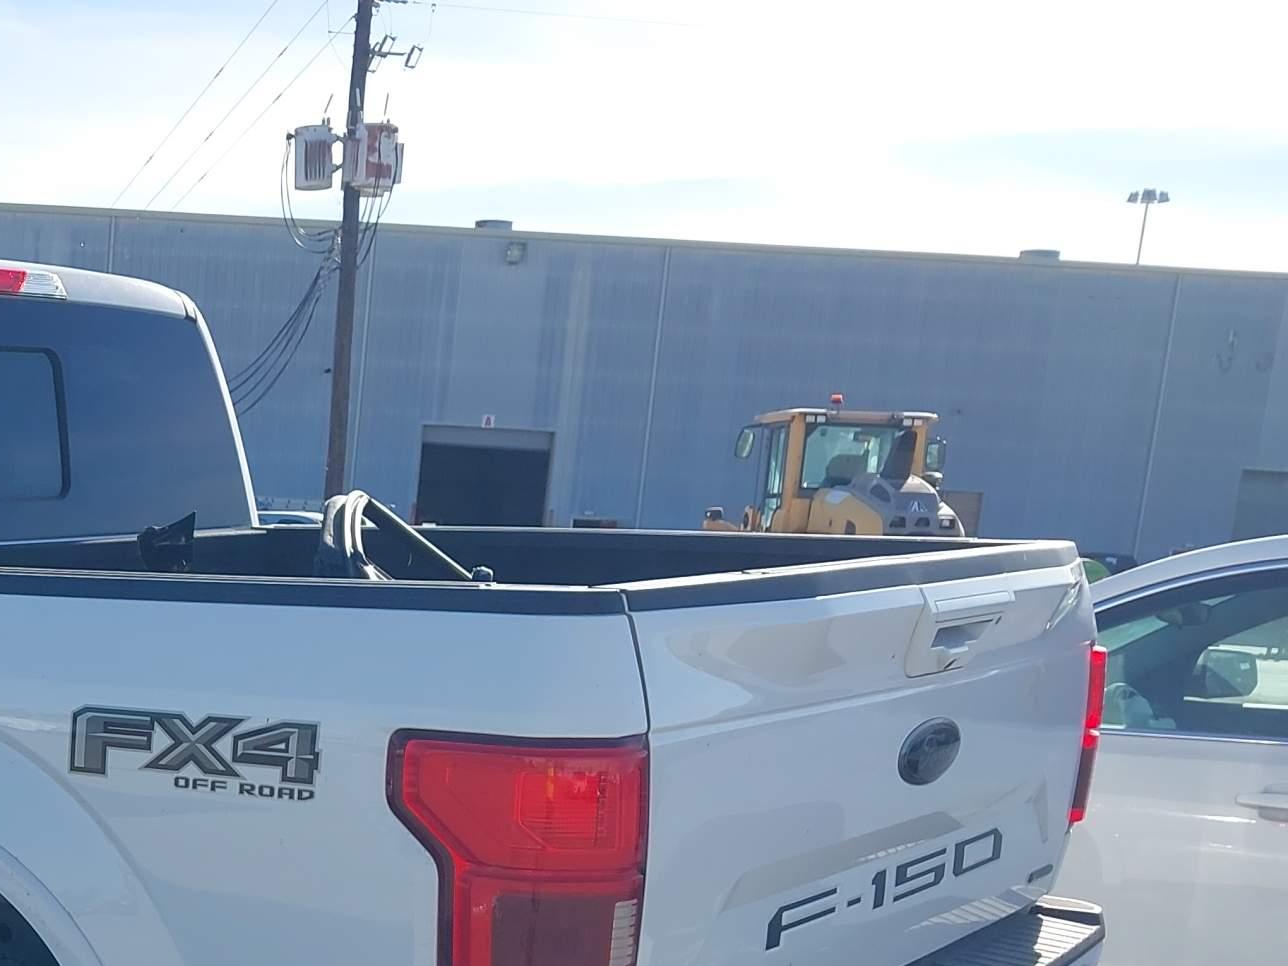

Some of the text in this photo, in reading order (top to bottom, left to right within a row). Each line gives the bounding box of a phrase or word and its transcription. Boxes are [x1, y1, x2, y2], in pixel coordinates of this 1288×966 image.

[69, 704, 321, 784] FX4
[174, 776, 316, 801] OFF ROAD
[765, 827, 1003, 951] F-150
